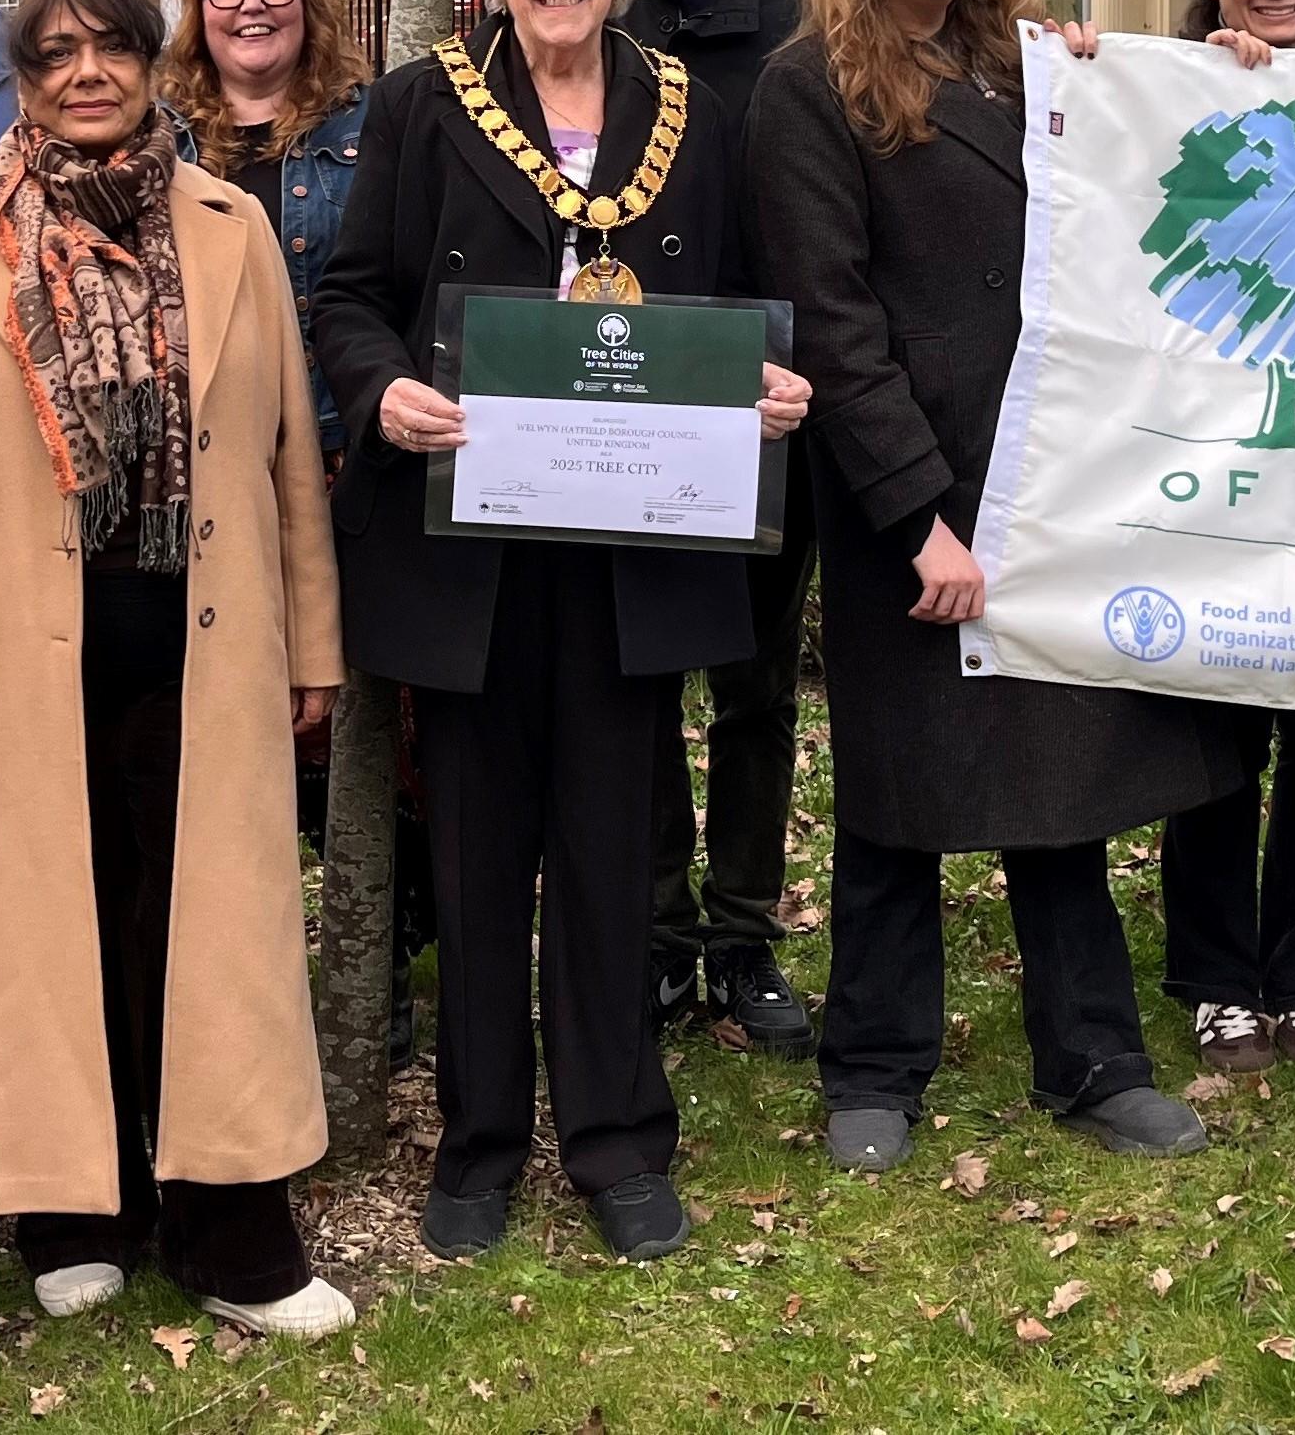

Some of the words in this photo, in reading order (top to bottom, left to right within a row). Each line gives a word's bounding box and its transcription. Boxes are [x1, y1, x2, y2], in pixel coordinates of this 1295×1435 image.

[580, 347, 607, 359] Tree
[610, 349, 645, 361] Cities
[612, 362, 639, 370] WORLD
[516, 423, 558, 433] WELWYN
[561, 426, 606, 436] HATFIELD
[608, 428, 655, 438] BOROUGH
[566, 438, 602, 448] UNITED
[604, 440, 650, 450] KINGDOM
[550, 458, 582, 471] 2025
[586, 461, 624, 474] TREE
[627, 463, 661, 476] CITY
[1160, 469, 1259, 507] OF
[1201, 601, 1248, 621] Food
[1255, 605, 1291, 625] and
[1199, 650, 1264, 670] United
